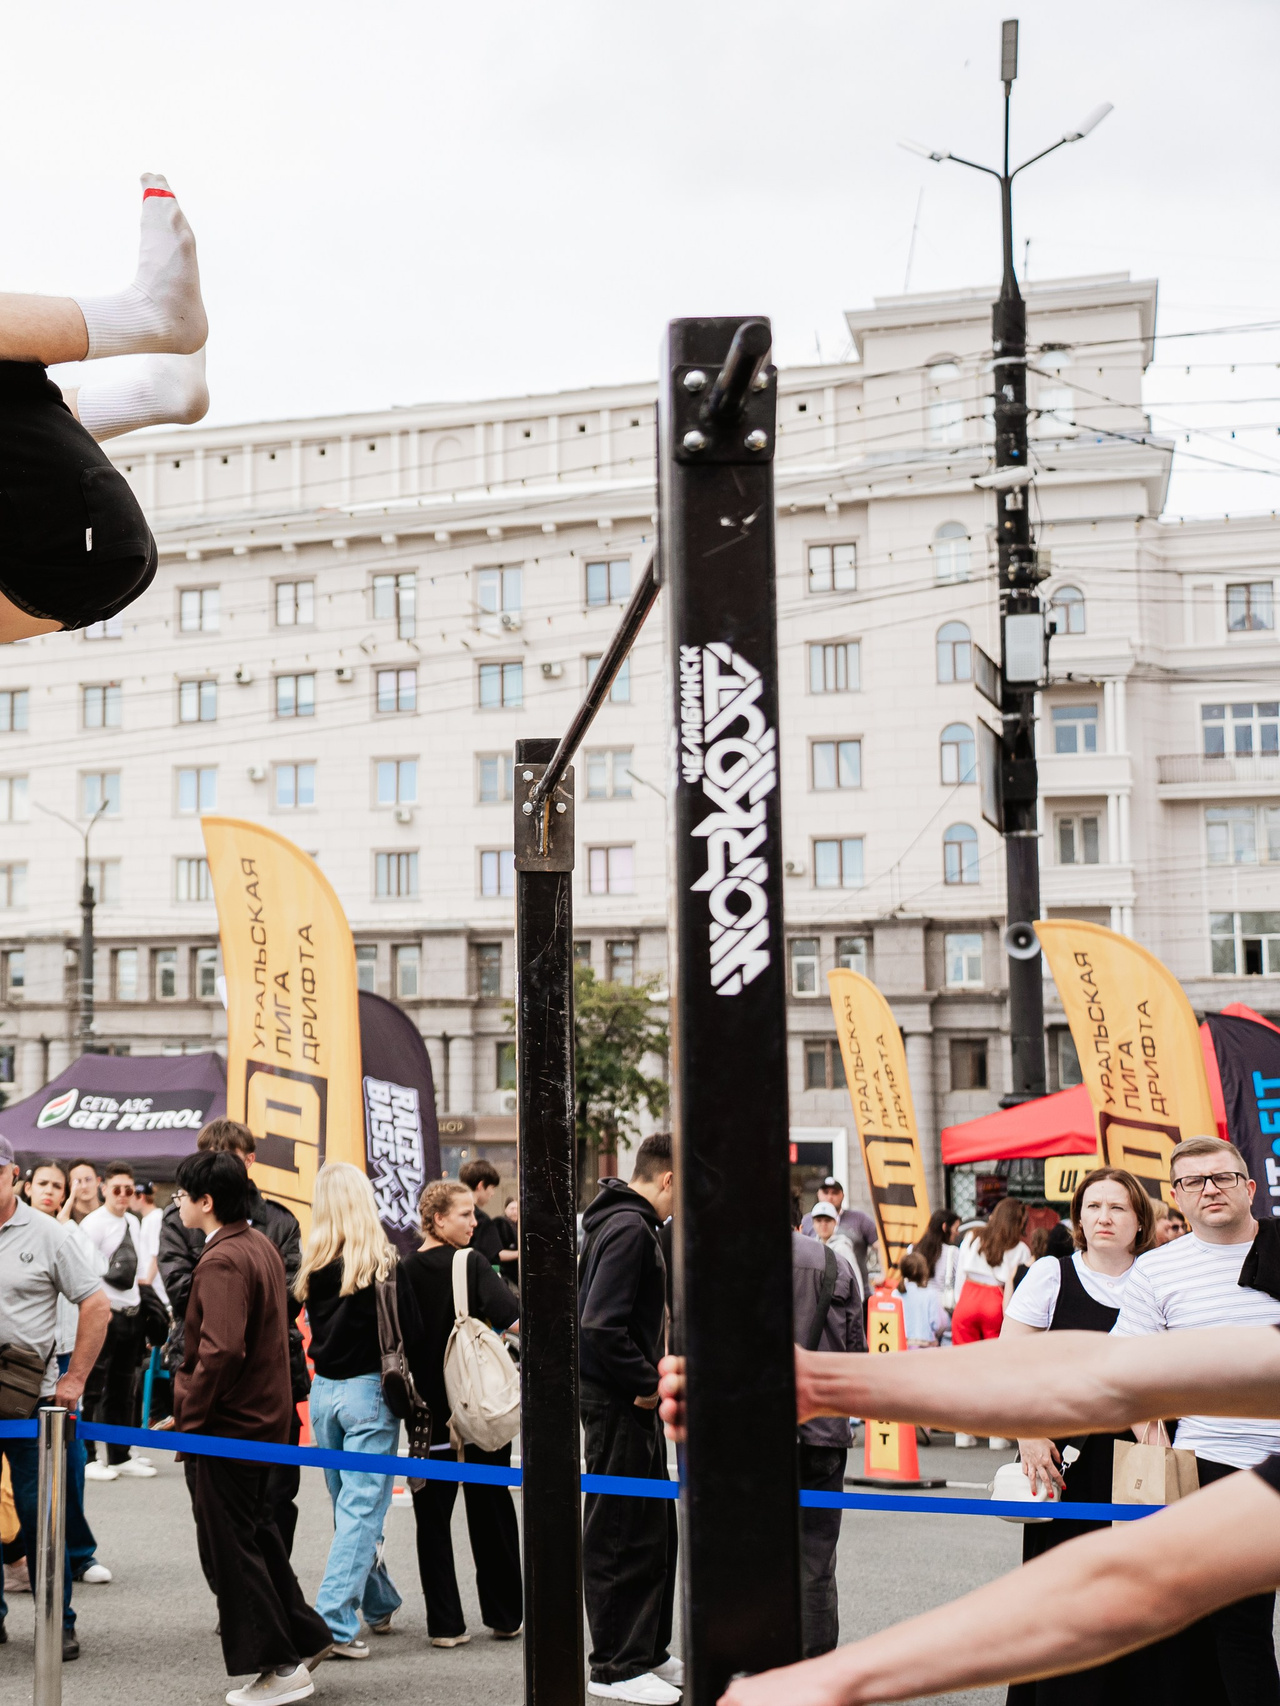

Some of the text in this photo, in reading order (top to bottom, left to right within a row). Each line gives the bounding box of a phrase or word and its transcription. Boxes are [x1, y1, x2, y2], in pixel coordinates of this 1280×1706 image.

[690, 641, 777, 996] WORKOUT
[241, 857, 268, 1049] УРАЛЬСКАЯ
[298, 924, 322, 1066] ДРИФТА
[274, 970, 293, 1058] ЛИГА
[1074, 951, 1116, 1105] УРАЛЬСКАЯ
[1137, 1000, 1170, 1117] ДРИФТА
[79, 1095, 154, 1113] СЕТЬ АЗС
[844, 995, 875, 1128] УРАЛЬСКАЯ
[872, 1069, 892, 1129] ЛИГА
[877, 1033, 910, 1129] ДРИФТА
[1118, 1040, 1142, 1113] ЛИГА
[69, 1108, 204, 1131] GET PETROL
[366, 1080, 397, 1164] BASE
[390, 1086, 422, 1170] RACE
